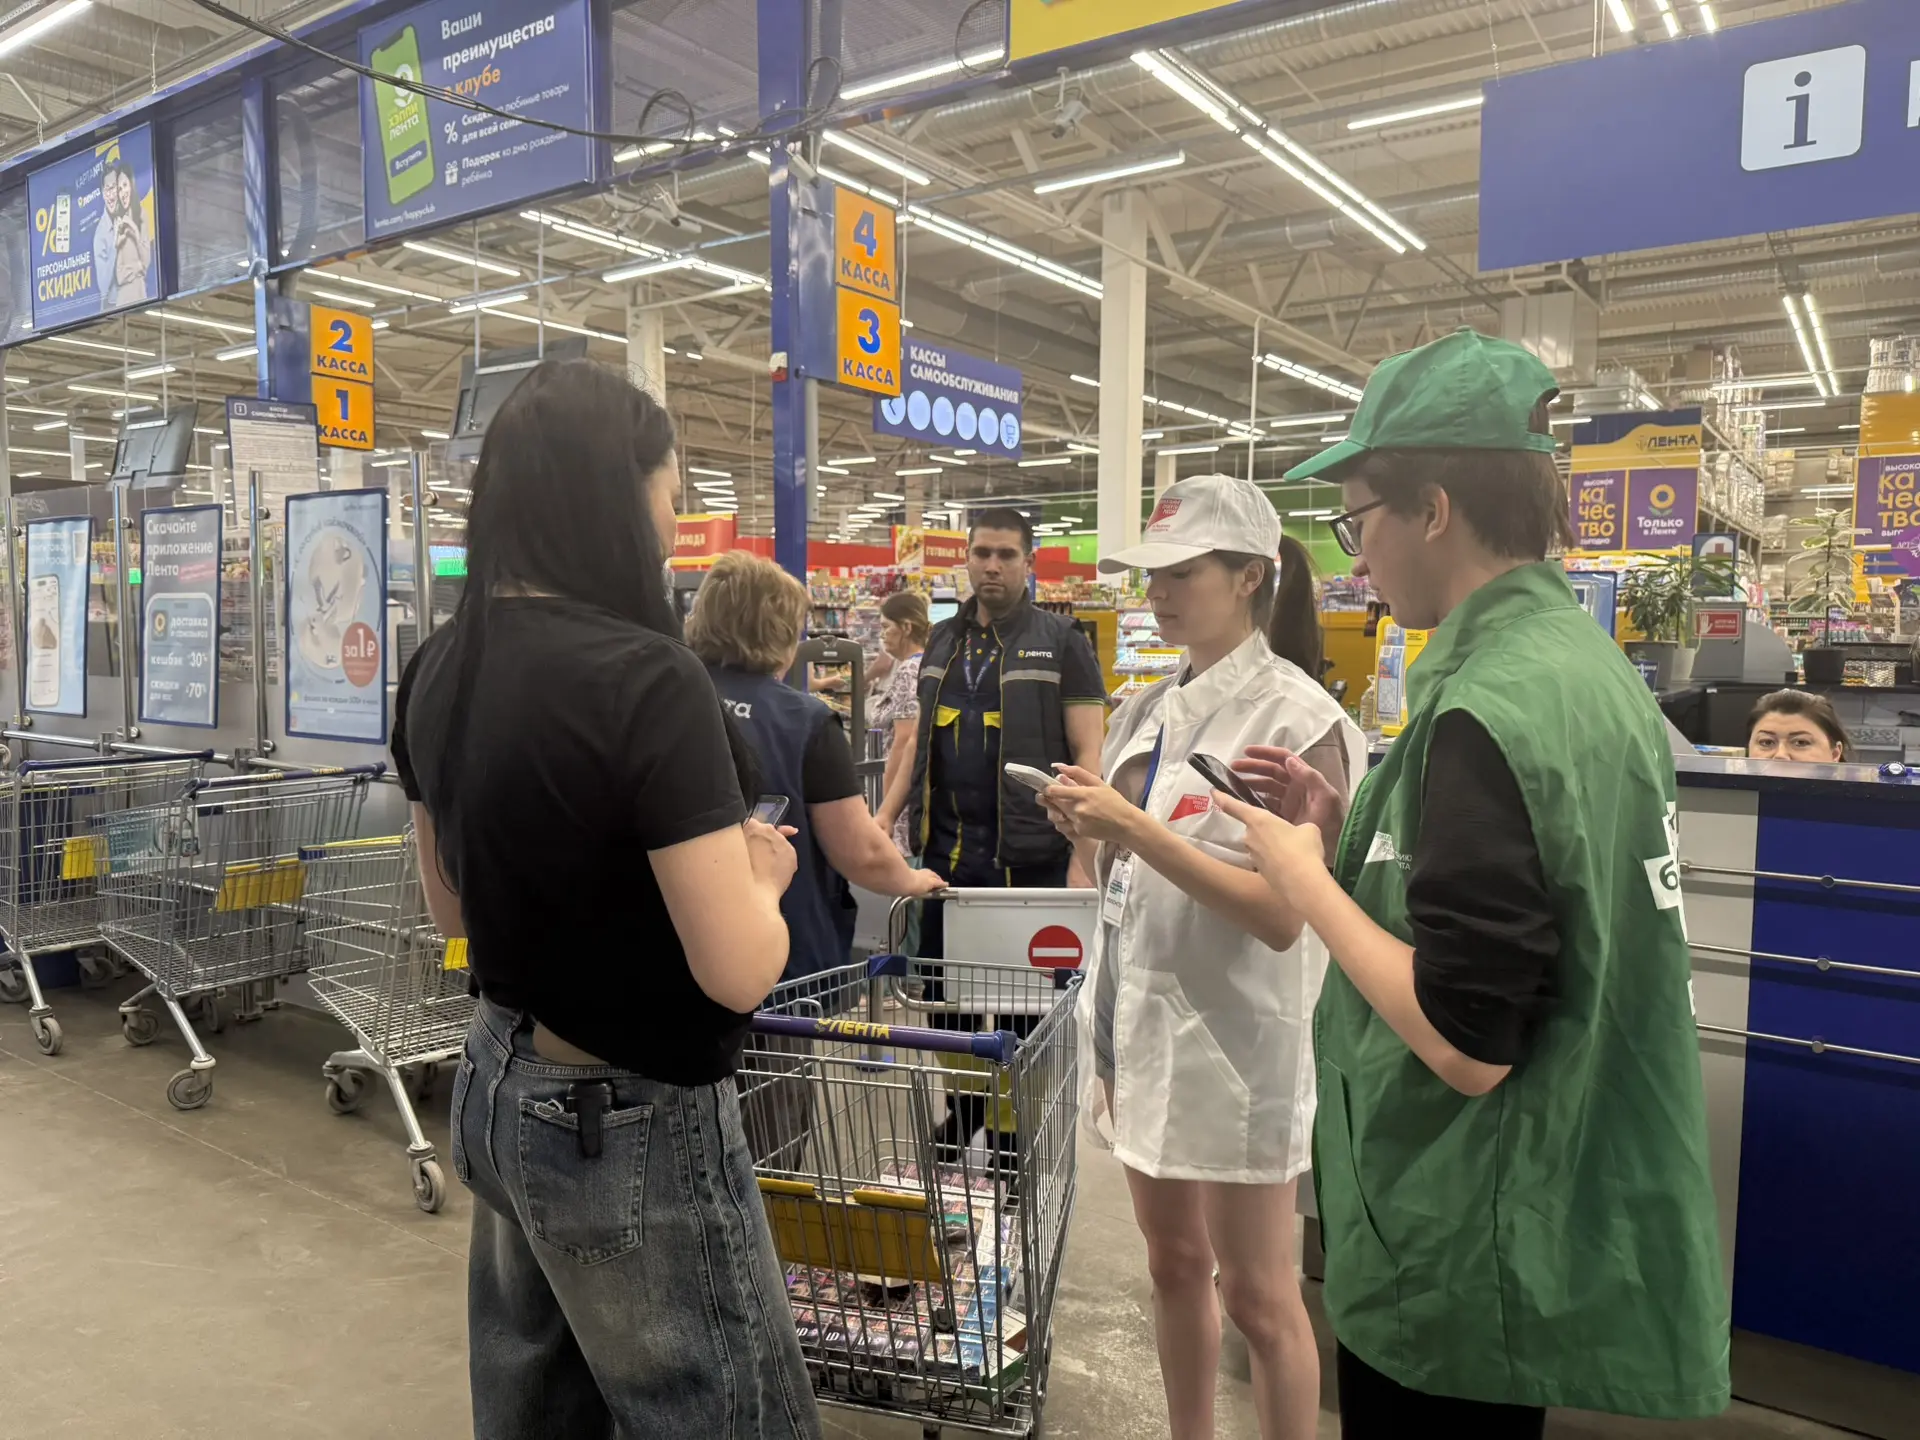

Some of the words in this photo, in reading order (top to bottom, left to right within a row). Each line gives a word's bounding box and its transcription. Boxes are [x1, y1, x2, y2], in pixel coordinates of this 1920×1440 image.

[441, 12, 482, 40] Ваши
[443, 14, 555, 73] преимущества
[455, 63, 501, 97] клубе
[542, 82, 570, 99] товары
[389, 114, 419, 141] лента
[462, 131, 478, 145] для
[479, 121, 498, 137] всей
[462, 150, 501, 169] Подарок
[502, 147, 511, 157] ко
[512, 142, 528, 155] дню
[853, 210, 877, 257] 4
[37, 251, 90, 279] ПЕРСОНАЛЬНЫЕ
[841, 257, 891, 292] КАССА
[38, 266, 91, 302] СКИДКИ
[329, 319, 353, 353] 2
[857, 308, 881, 354] 3
[317, 354, 368, 375] КАССА
[910, 345, 946, 369] КАССЫ
[843, 358, 895, 387] КАССА
[910, 363, 1019, 404] САМООБСЛУЖИВАНИЯ
[335, 389, 349, 421] 1
[318, 424, 368, 443] КАССА
[1647, 434, 1698, 449] ЛЕНТА
[1880, 472, 1914, 490] ка
[1579, 487, 1605, 504] ка
[1578, 503, 1615, 520] чес
[1637, 516, 1684, 528] Только
[146, 518, 197, 535] Скачайте
[1578, 520, 1615, 537] тво
[1650, 527, 1677, 535] Ленте
[146, 541, 214, 561] приложение
[1024, 650, 1053, 658] лента
[828, 1019, 890, 1039] ЛЕНТА
